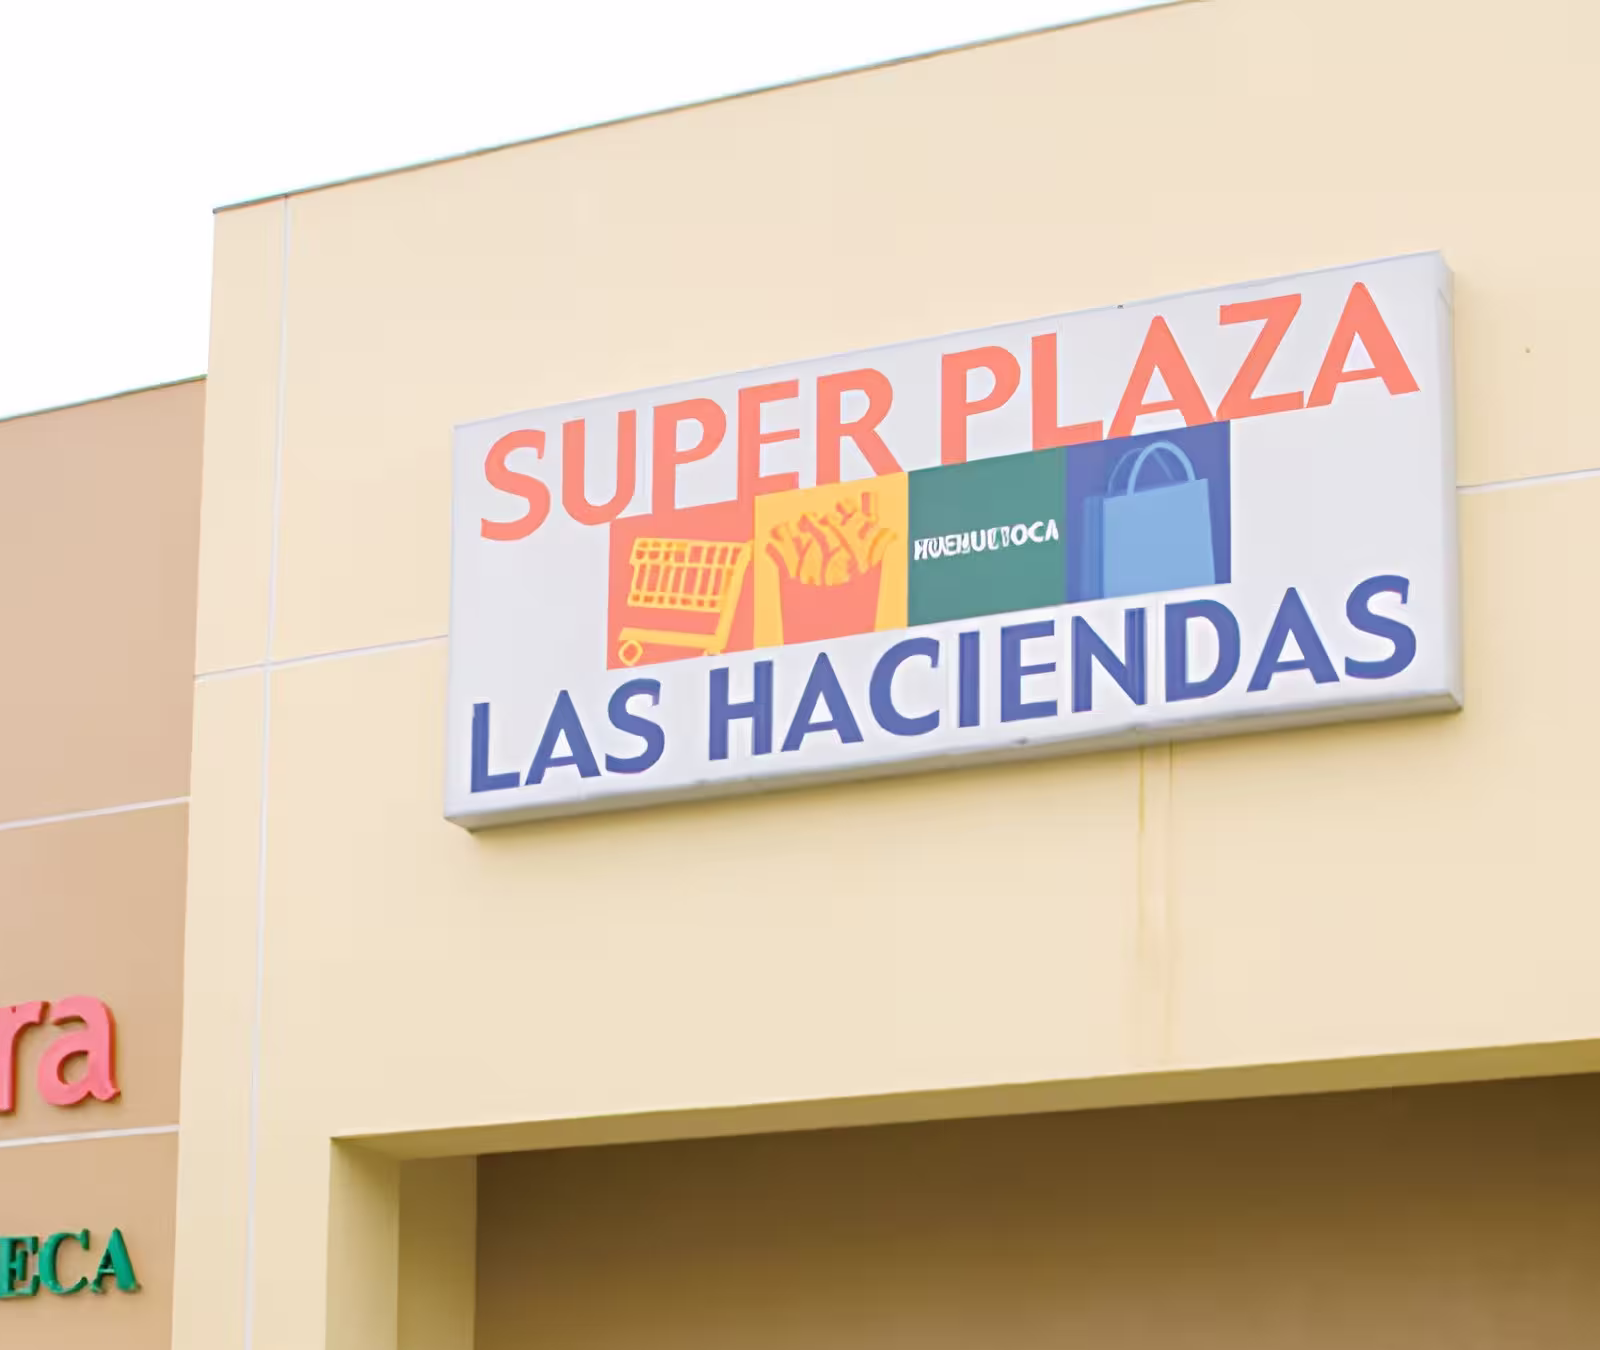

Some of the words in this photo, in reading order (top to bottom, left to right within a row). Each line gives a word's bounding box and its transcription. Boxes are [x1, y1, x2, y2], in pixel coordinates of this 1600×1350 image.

[480, 366, 903, 542] SUPER
[940, 281, 1420, 464] PLAZA
[470, 677, 666, 794] LAS
[707, 573, 1418, 761] HACIENDAS
